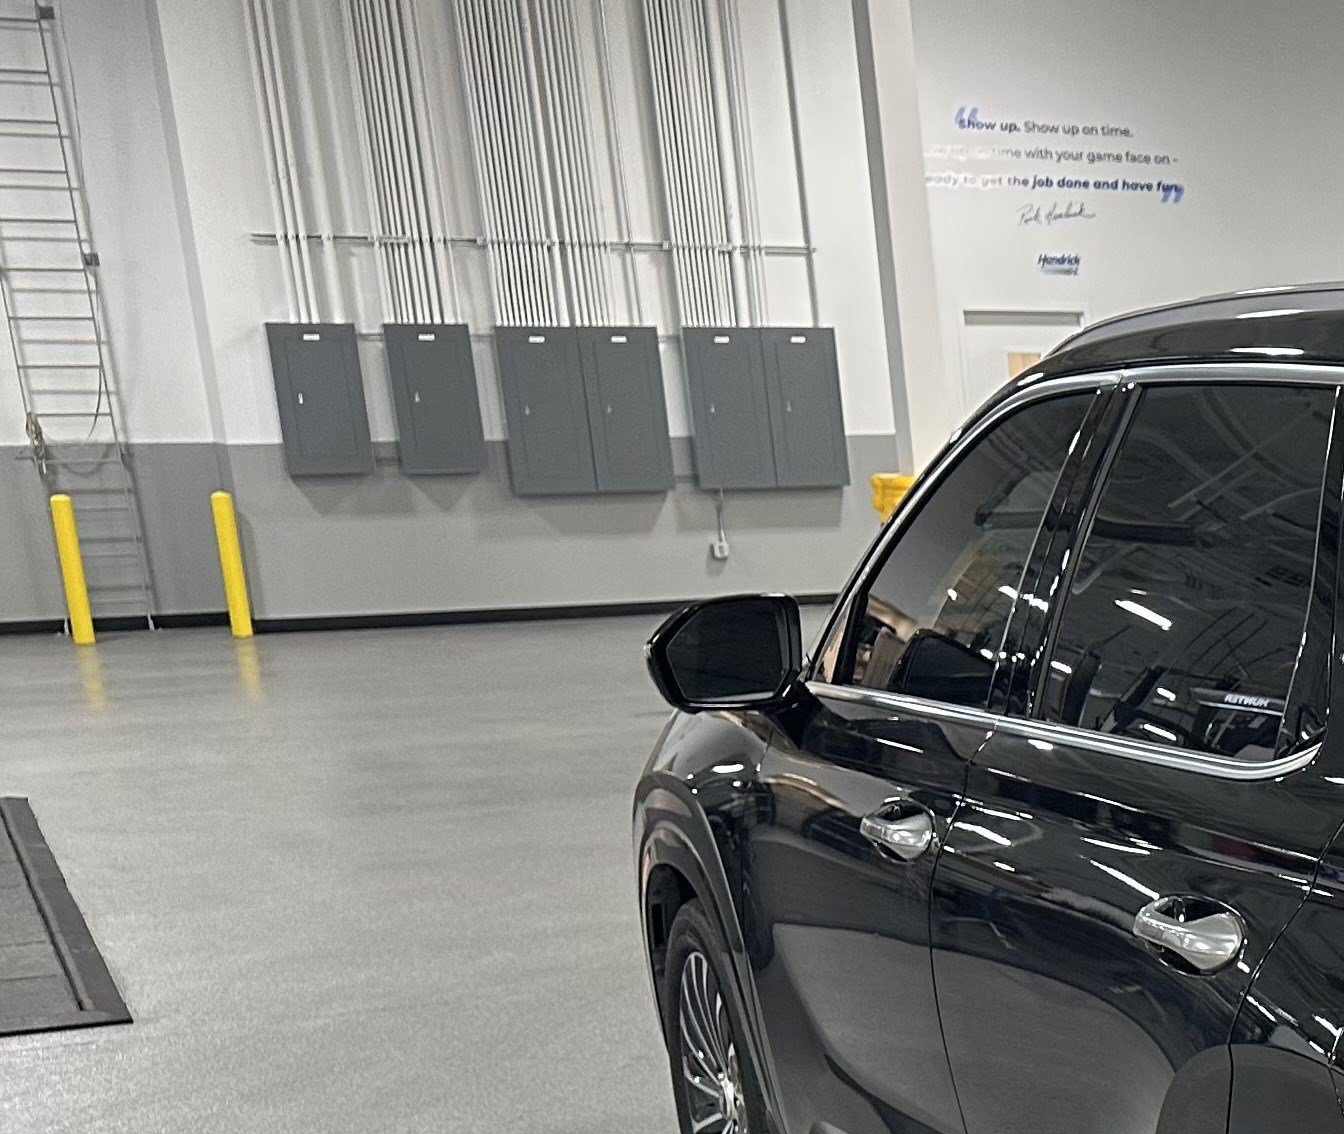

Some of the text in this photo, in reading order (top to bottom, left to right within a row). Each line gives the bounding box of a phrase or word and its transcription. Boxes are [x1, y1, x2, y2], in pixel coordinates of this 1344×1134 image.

[1023, 119, 1059, 135] Show
[1061, 122, 1080, 138] up
[1082, 124, 1098, 136] on
[1100, 123, 1134, 138] time.
[1023, 146, 1053, 160] with
[1055, 151, 1083, 165] your
[1086, 152, 1123, 166] game
[1125, 150, 1152, 164] face
[1153, 152, 1171, 165] on
[1007, 174, 1030, 187] the
[1031, 173, 1054, 189] job
[1056, 175, 1090, 189] done
[1093, 178, 1119, 191] and
[1121, 178, 1154, 192] have
